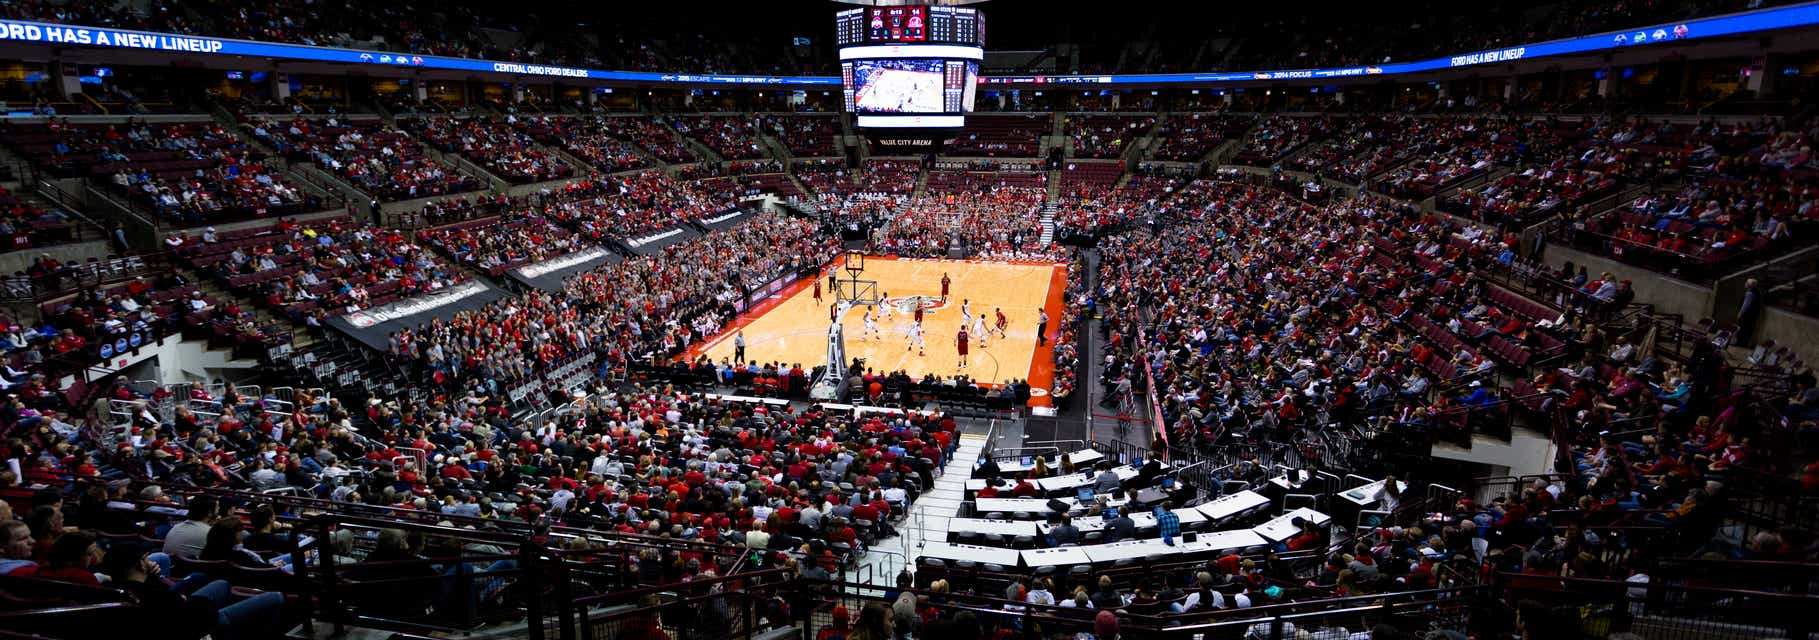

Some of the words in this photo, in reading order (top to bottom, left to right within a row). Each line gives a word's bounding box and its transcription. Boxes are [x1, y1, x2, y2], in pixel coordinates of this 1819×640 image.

[46, 27, 92, 44] HAS
[96, 31, 111, 46] A
[114, 32, 157, 49] NEW
[161, 36, 223, 53] LINEUP
[1451, 55, 1466, 67] FORD
[1466, 53, 1479, 65] HAS
[1478, 53, 1484, 64] A
[1484, 51, 1499, 63] NEW
[1500, 47, 1525, 61] LINEUP
[494, 63, 527, 74] CENTRAL
[527, 65, 544, 75] OHIO
[545, 66, 562, 76] FORD
[562, 67, 588, 78] DEALERS
